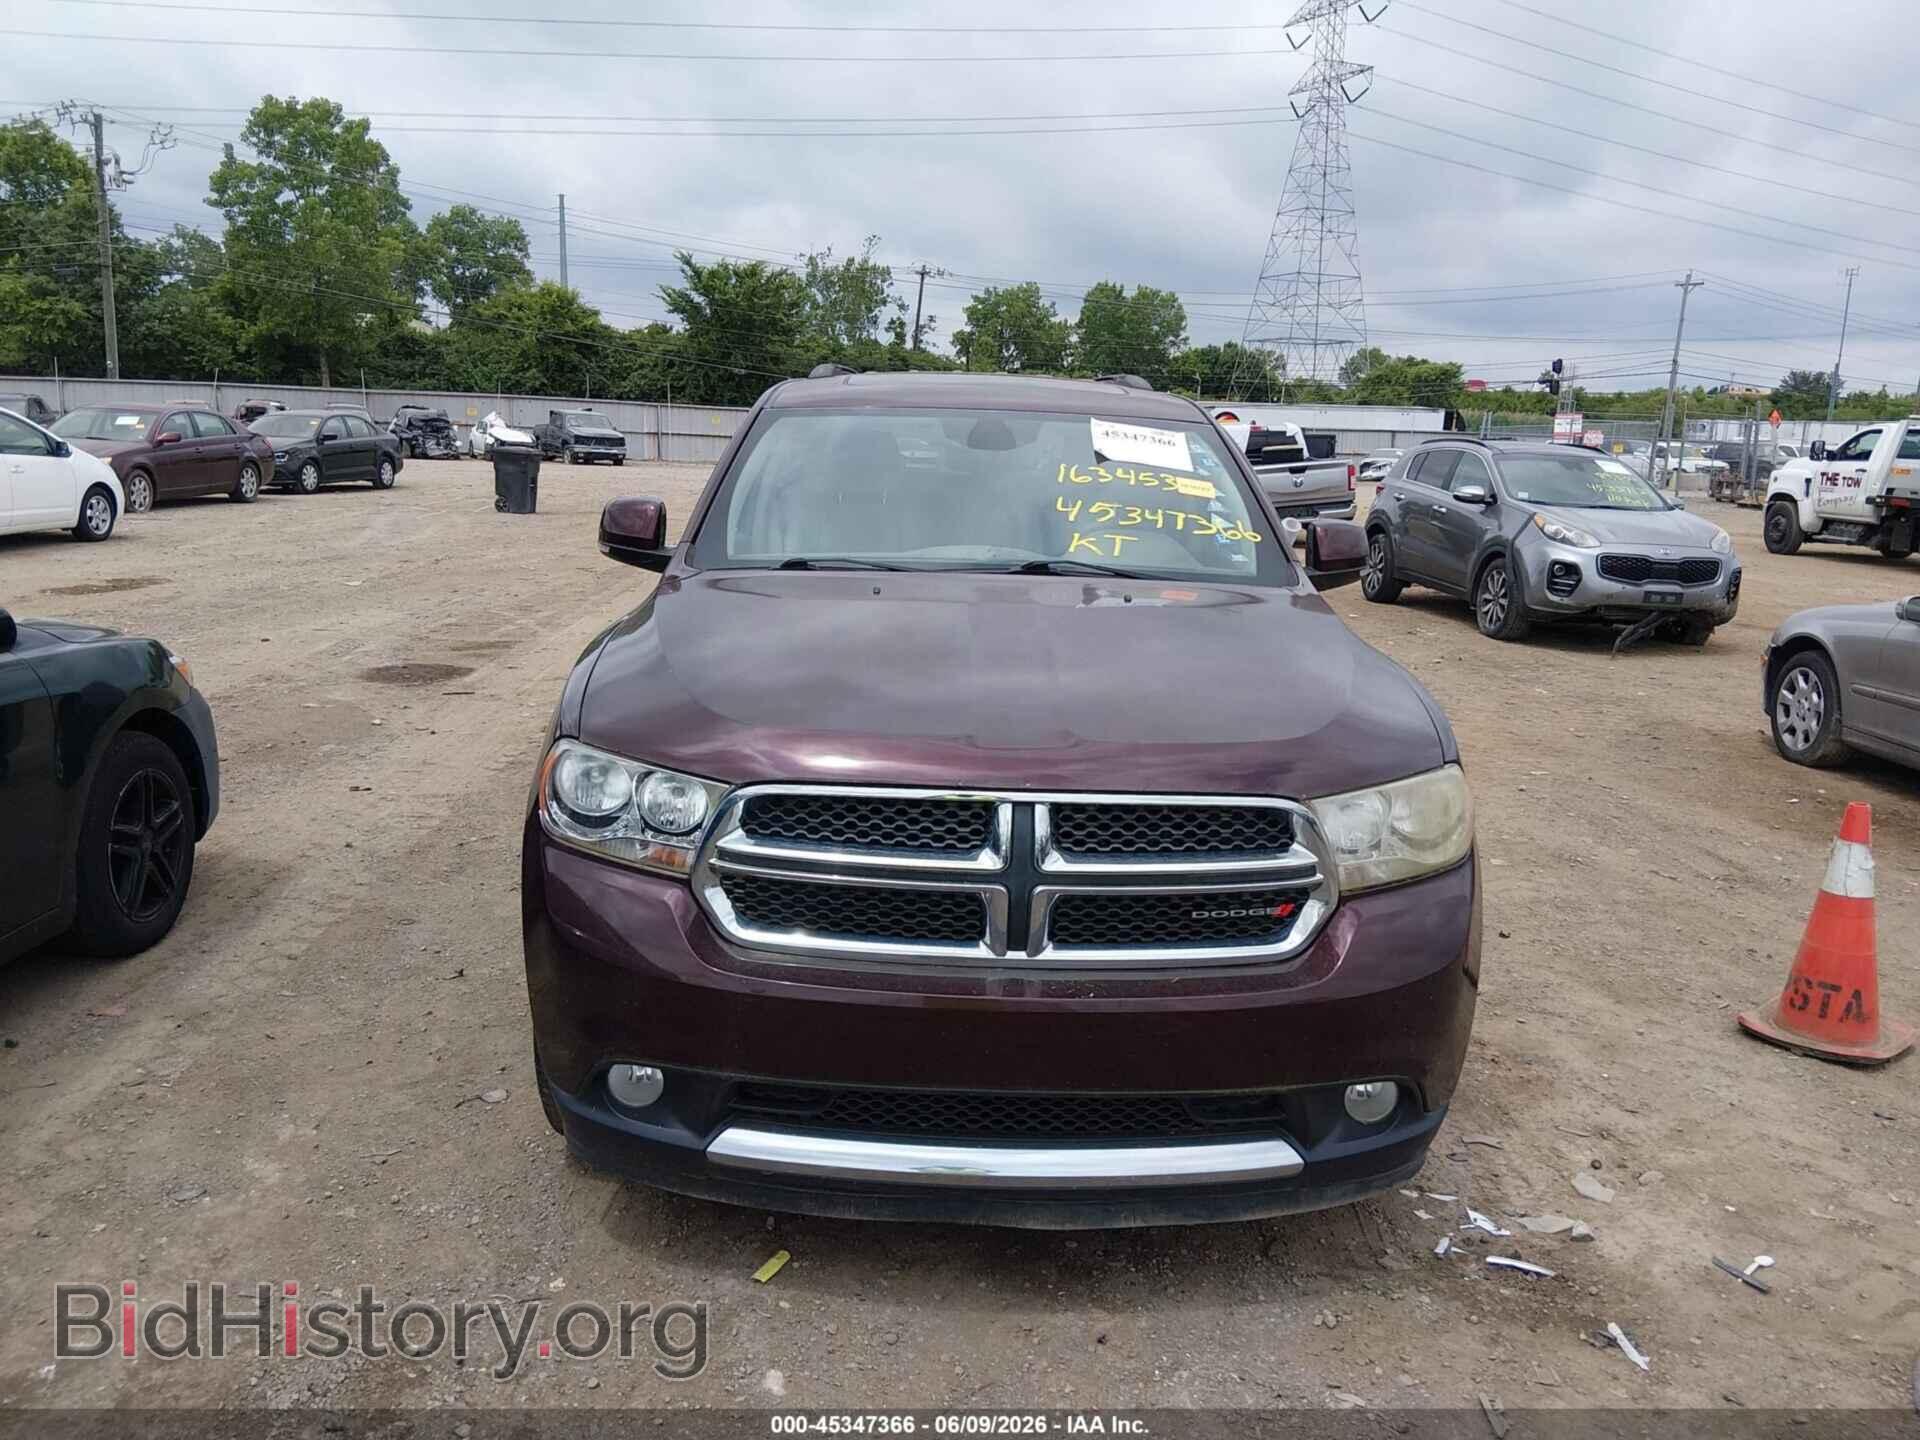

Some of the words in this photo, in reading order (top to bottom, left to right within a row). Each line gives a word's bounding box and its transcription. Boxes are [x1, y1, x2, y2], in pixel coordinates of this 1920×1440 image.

[1820, 471, 1840, 487] THE
[1841, 476, 1863, 489] TOW
[1056, 496, 1262, 543] 45347366
[1068, 532, 1138, 557] KT
[1191, 907, 1283, 919] DODGE
[1789, 976, 1869, 1025] STA
